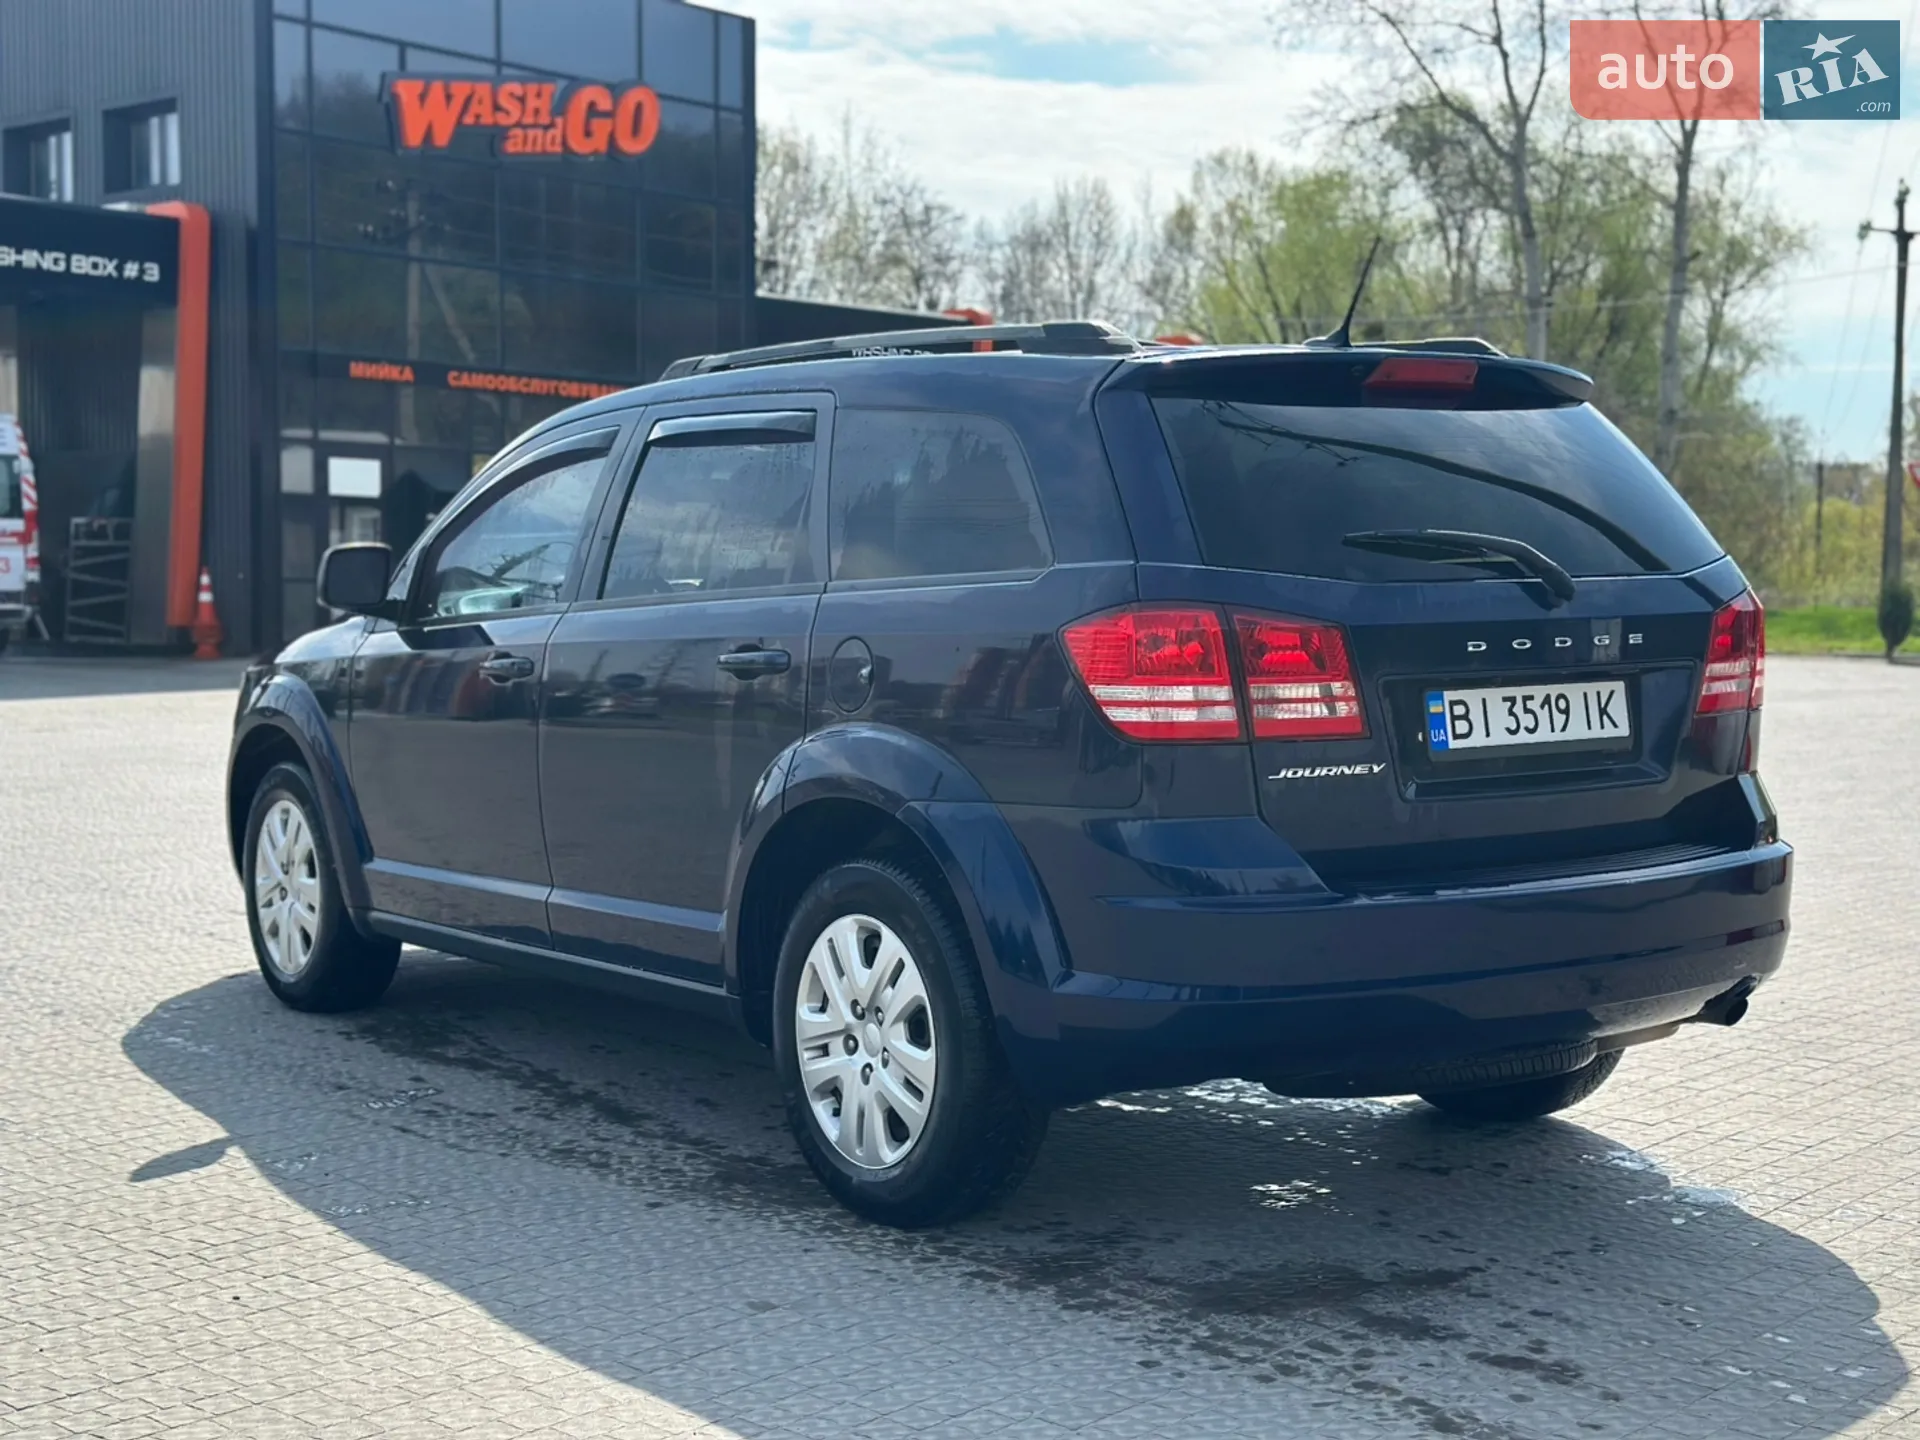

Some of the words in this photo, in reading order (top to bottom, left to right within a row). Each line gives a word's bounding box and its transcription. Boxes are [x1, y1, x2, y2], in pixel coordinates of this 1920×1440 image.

[392, 79, 558, 148] WASH
[504, 116, 565, 154] and
[565, 85, 661, 155] GO
[70, 253, 119, 278] BOX
[349, 360, 415, 383] МИЙКА
[1467, 633, 1643, 652] DODGE
[1448, 698, 1491, 742] BI
[1504, 693, 1571, 736] 3519
[1583, 689, 1620, 731] IK
[1431, 729, 1447, 742] UA
[1268, 762, 1387, 780] JOURNEY
